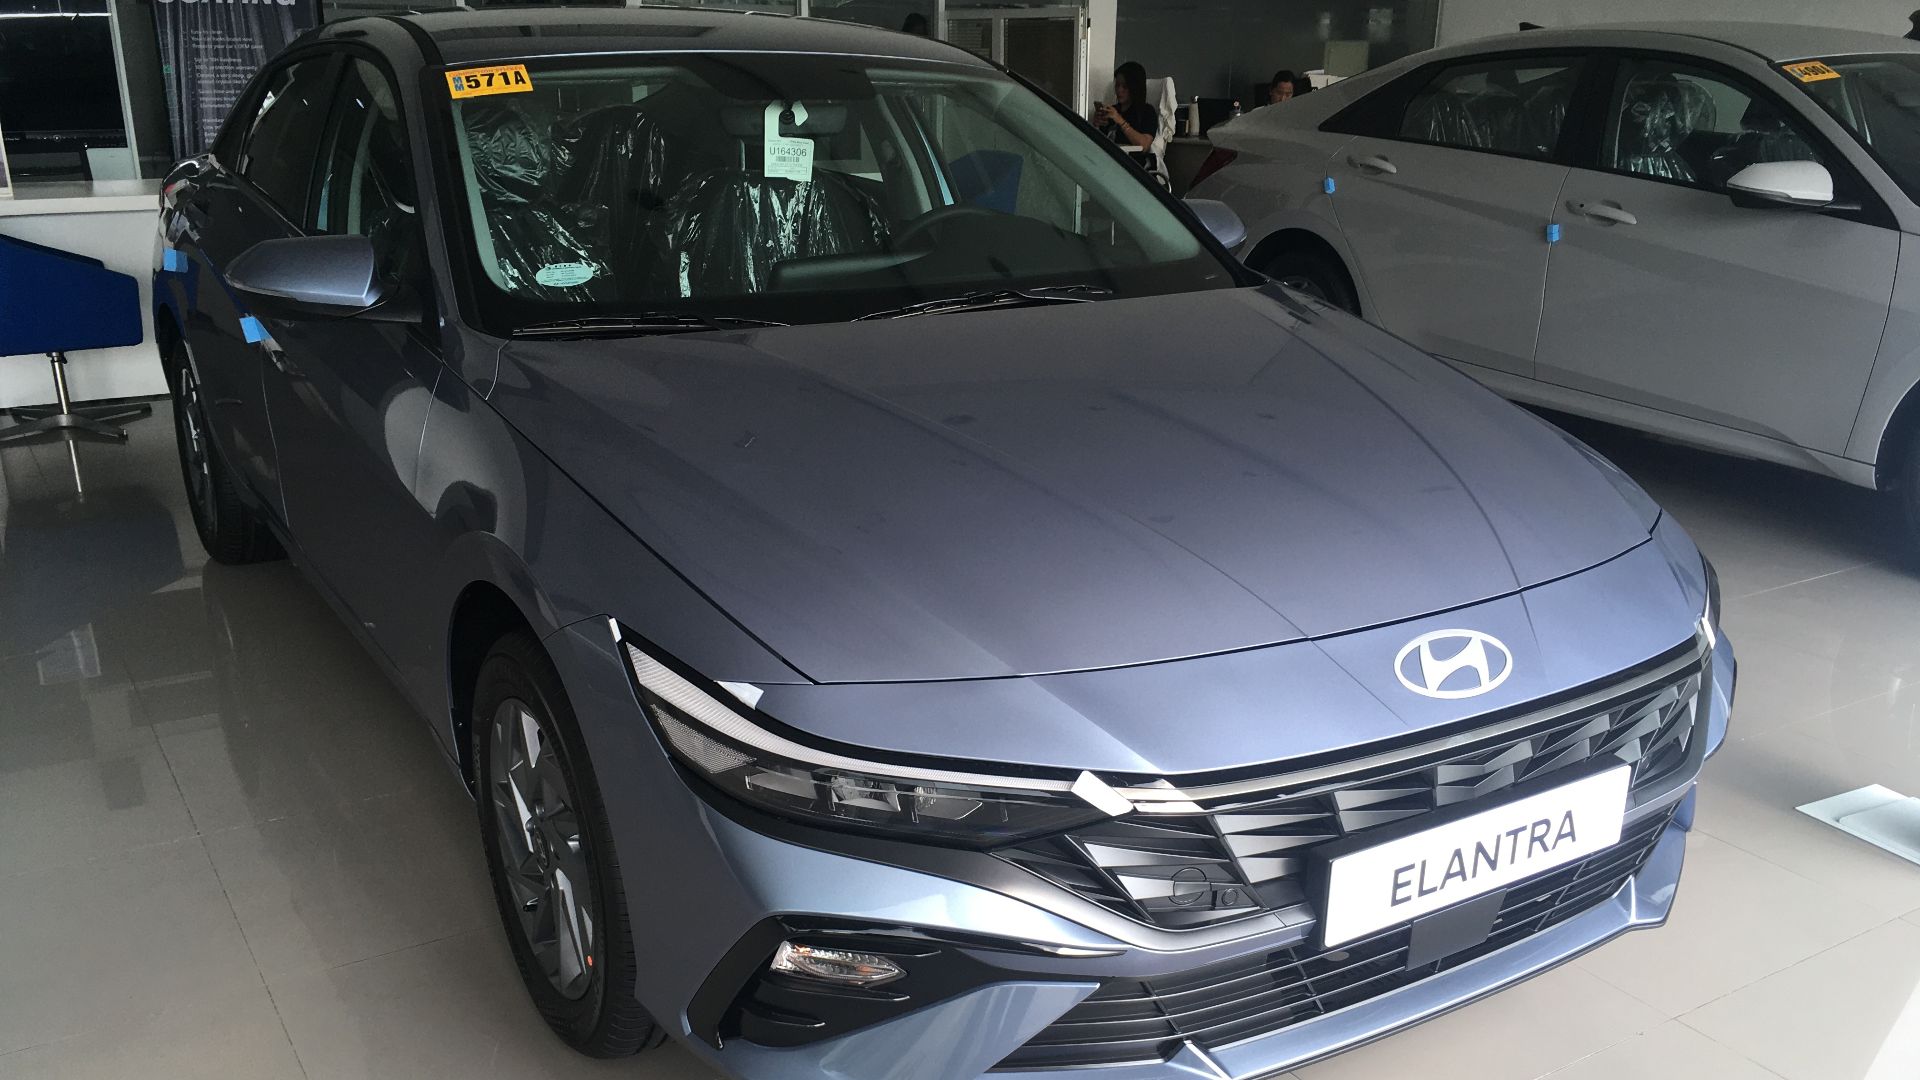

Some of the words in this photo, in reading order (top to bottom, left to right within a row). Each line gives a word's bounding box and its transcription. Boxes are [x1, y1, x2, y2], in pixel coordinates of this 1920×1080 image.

[465, 71, 526, 89] 571A
[769, 147, 807, 157] U164306
[1391, 810, 1576, 907] ELANTRA
